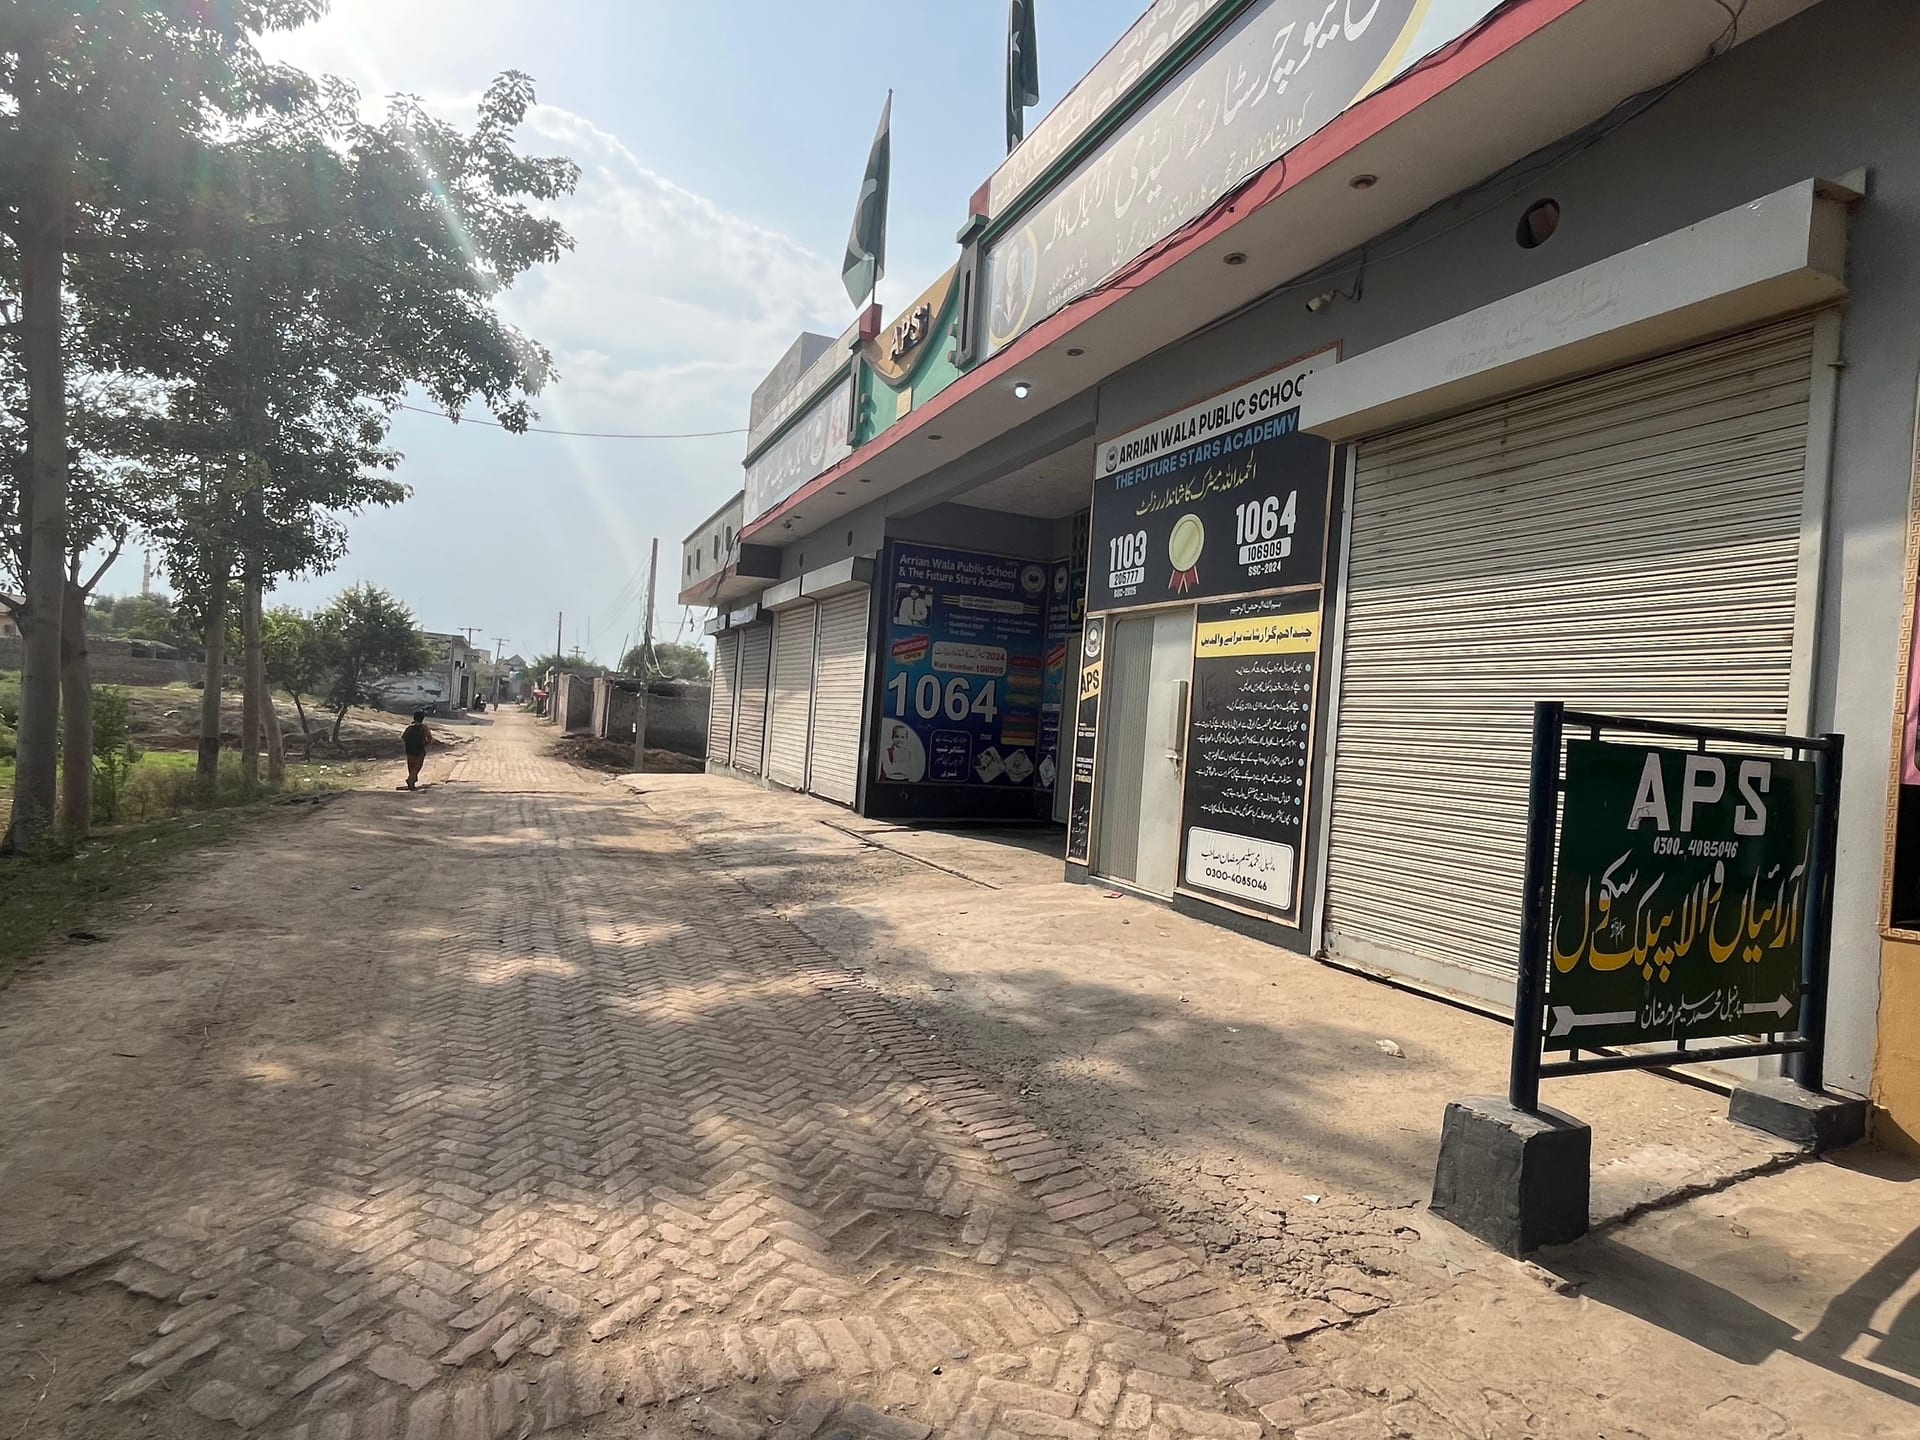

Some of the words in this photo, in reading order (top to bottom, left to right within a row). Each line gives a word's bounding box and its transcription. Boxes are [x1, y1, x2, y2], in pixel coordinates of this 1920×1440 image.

[1119, 432, 1159, 465] ARRIAN
[1160, 418, 1196, 449] WALA
[1199, 398, 1246, 435] PUBLIC
[1249, 370, 1311, 415] SCHOO
[1115, 470, 1135, 490] THE
[1134, 455, 1178, 484] FUTURE
[1179, 440, 1220, 468] STARS
[1223, 411, 1298, 454] ACADEMY
[1236, 490, 1297, 545] 1064
[899, 554, 930, 567] Arrian
[931, 557, 955, 570] Wala
[957, 561, 984, 575] Public
[986, 565, 1017, 578] School
[1109, 530, 1148, 572] 1103
[1247, 541, 1282, 562] 106909
[1248, 561, 1282, 576] SSC-2024
[898, 566, 906, 576] &
[907, 567, 924, 578] The
[925, 569, 954, 583] Future
[955, 573, 977, 585] Stars
[978, 577, 1016, 592] Academy
[888, 671, 998, 723] 1064
[1080, 669, 1100, 695] APS
[1627, 752, 1772, 836] APS
